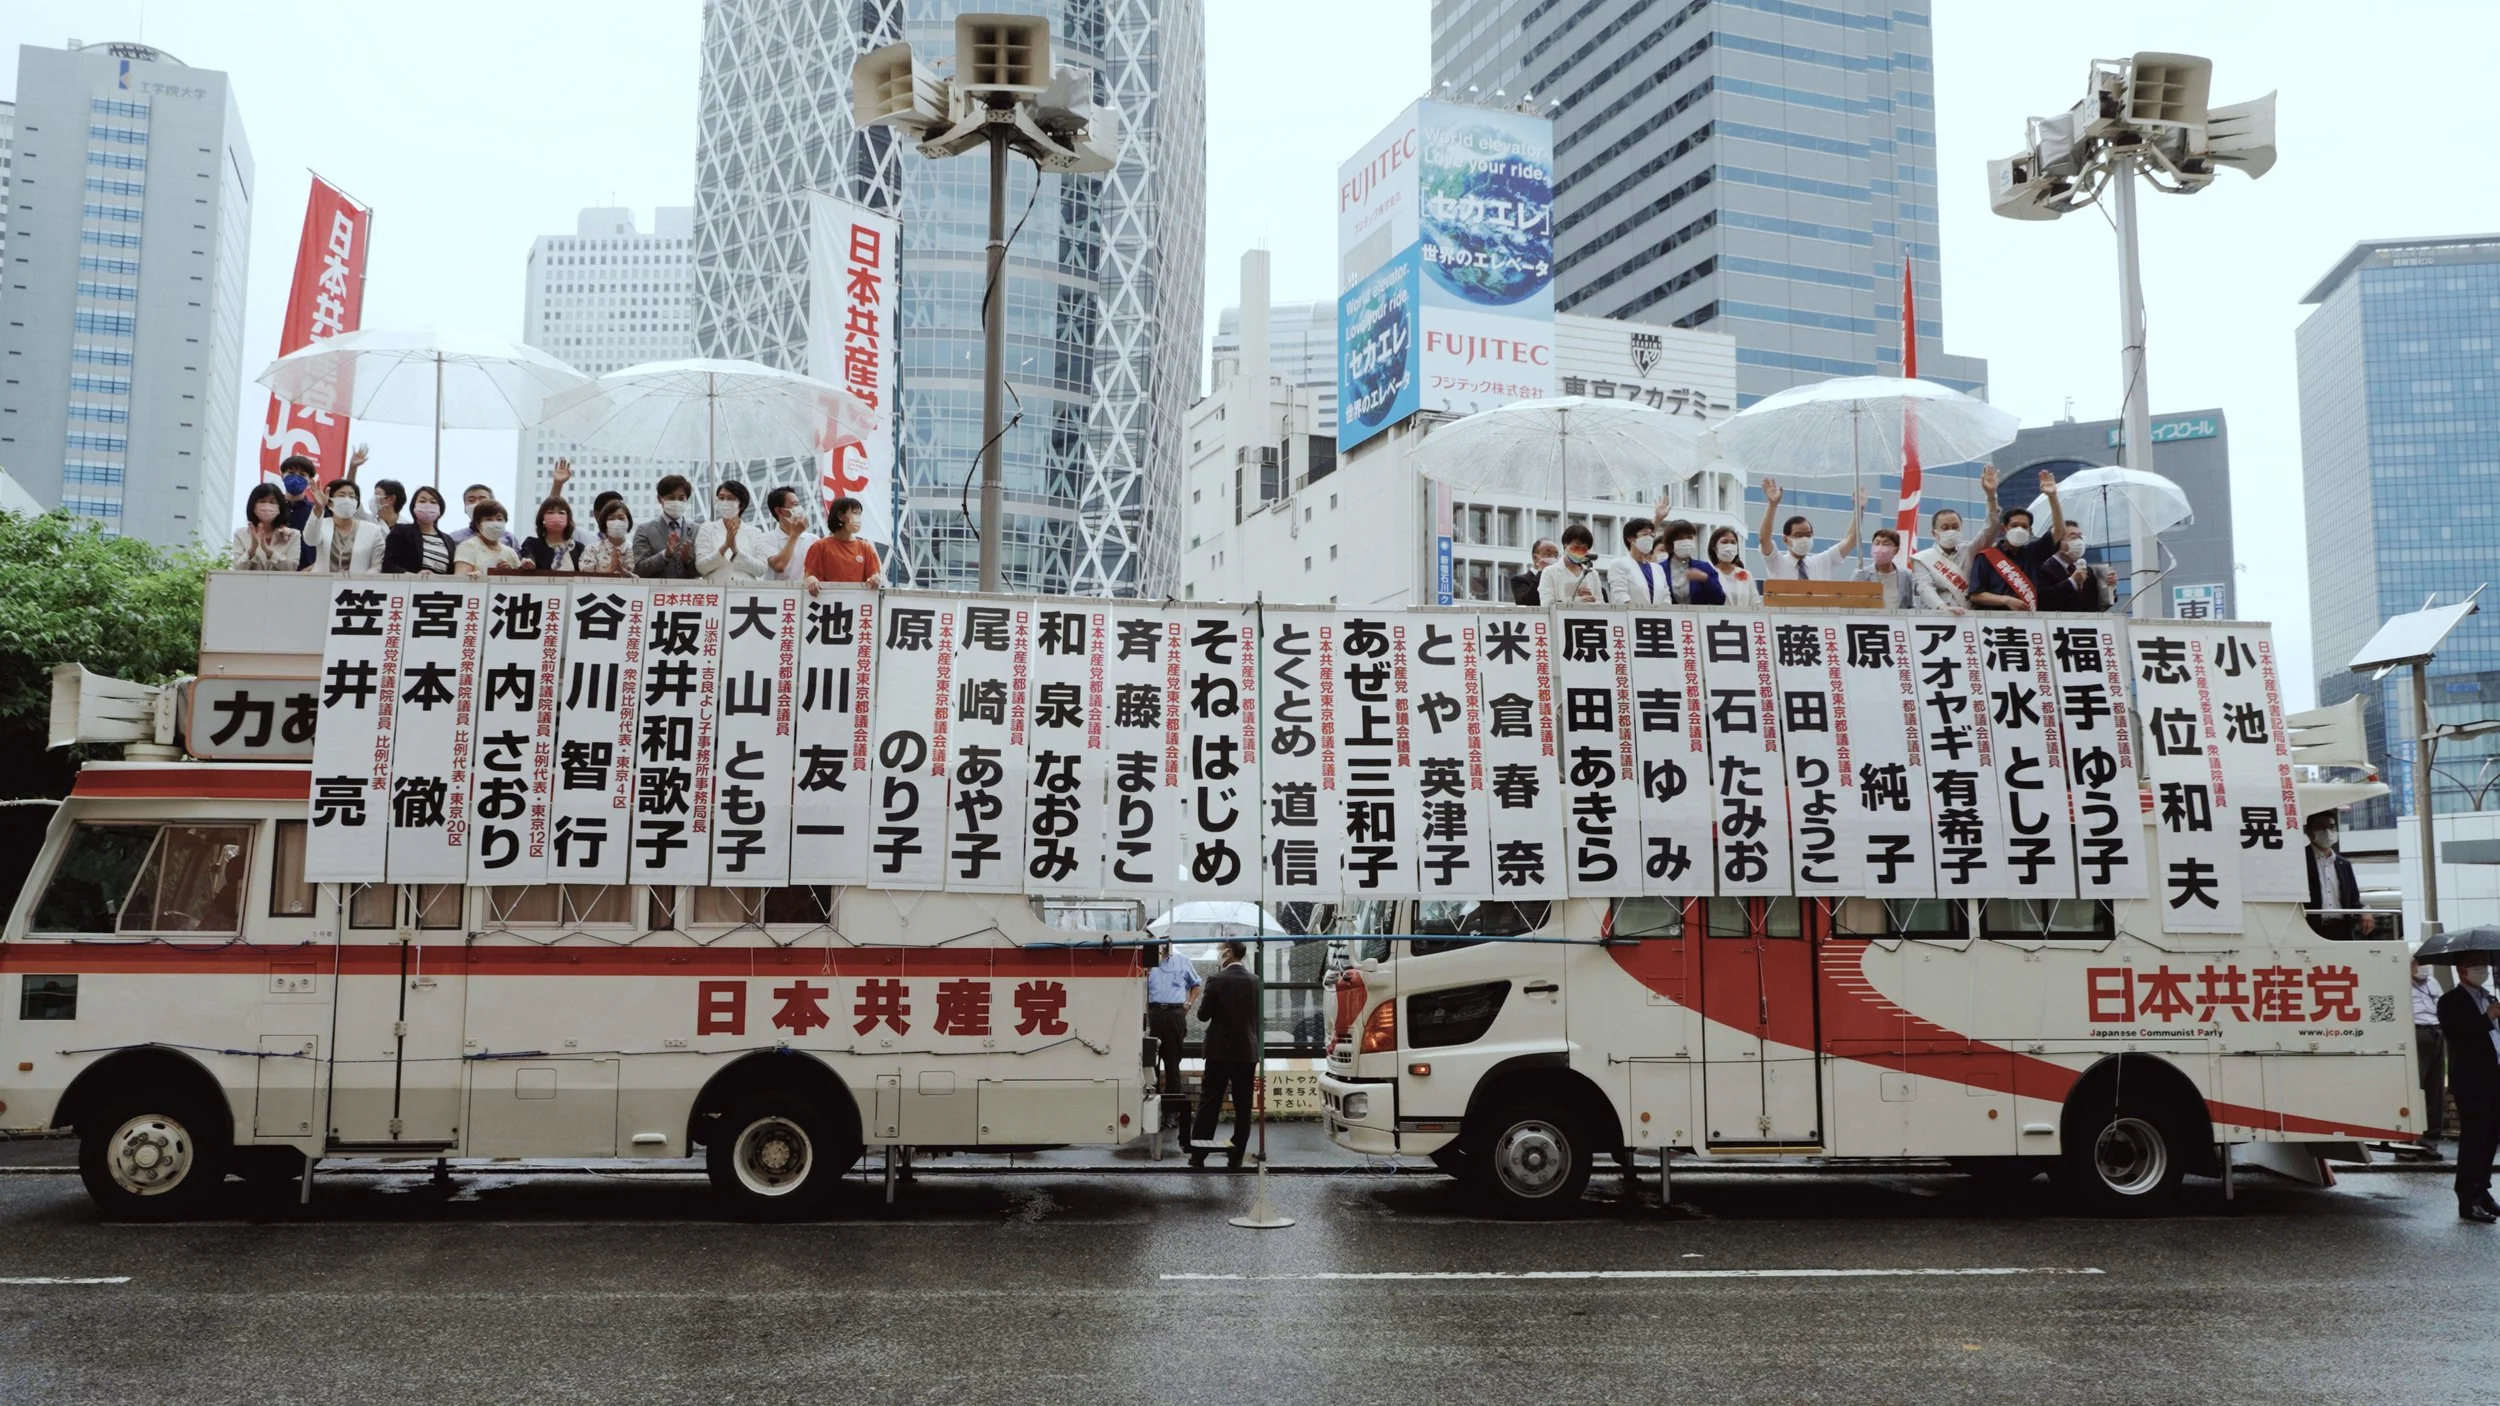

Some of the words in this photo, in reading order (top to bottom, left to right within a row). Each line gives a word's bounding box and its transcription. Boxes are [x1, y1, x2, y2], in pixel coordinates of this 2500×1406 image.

[1341, 128, 1416, 214] FUJITEC
[1424, 127, 1473, 149] World
[1469, 160, 1506, 174] your
[1345, 288, 1371, 316] World
[1373, 262, 1410, 298] elevator.
[1389, 288, 1410, 311] ride.
[1421, 244, 1549, 278] 世界のエレベータ
[1345, 369, 1411, 425] 世界のエレベータ
[1426, 331, 1549, 366] FUJITEC
[1430, 375, 1545, 399] フジテック株式会社
[1562, 376, 1730, 420] 東京アカデミー
[653, 593, 719, 608] 日本共産党
[775, 598, 796, 736] 日本共産党都議会議員
[1009, 611, 1029, 746] 日本共産党都議会議員
[1087, 612, 1106, 750] 日本共産党都議会議員
[210, 690, 319, 747] 力あ
[477, 592, 543, 870] 池内さおり
[553, 592, 627, 868] 谷川智行
[635, 610, 703, 869] 坂井和歌子
[717, 596, 777, 873] 大山とも子
[796, 600, 854, 836] 池川友一
[852, 603, 873, 772] 日本共産党東京都議会議員
[930, 613, 954, 777] 日本共産党東京都議会議員
[951, 606, 1012, 879] 尾崎あや子
[1029, 610, 1087, 883] 和泉なおみ
[1112, 618, 1164, 883] 斉藤まりこ
[1164, 623, 1182, 788] 日本共産党東京都議会議員
[1190, 619, 1242, 887] そねはじめ
[1270, 623, 1319, 887] とくとめ道信
[1319, 627, 1337, 791] 日本共産党東京都議会議員
[1343, 618, 1398, 889] あぜ上三和子
[1417, 624, 1470, 886] とや英津子
[1462, 627, 1484, 791] 日本共産党東京都議会議員
[1484, 620, 1545, 887] 米倉春奈
[1534, 622, 1555, 757] 日本共産党都議会議員
[1562, 618, 1619, 883] 原田あきら
[1612, 625, 1634, 781] 日本共産党東京都議会議員
[1634, 617, 1692, 882] 里吉ゆみ
[1680, 620, 1704, 753] 日本共産党都議会議員
[1706, 619, 1769, 883] 白石たみお
[1753, 621, 1778, 752] 日本共産党都議会議員
[1775, 624, 1839, 884] 藤田りょうこ
[1824, 628, 1853, 788] 日本共産党東京都議会議員
[1915, 624, 1988, 885] アオヤギ有希子
[1982, 626, 2056, 885] 清水とし子
[2052, 627, 2129, 885] 福手ゆう子
[2137, 636, 2220, 910] 志位和夫
[696, 978, 1069, 1036] 日本共産党
[2087, 965, 2361, 1023] 日本共産党
[2090, 1029, 2137, 1039] Japanese
[2140, 1029, 2195, 1038] Communist
[2198, 1029, 2223, 1039] Party
[2299, 1029, 2364, 1039] www.jcp.or.jp
